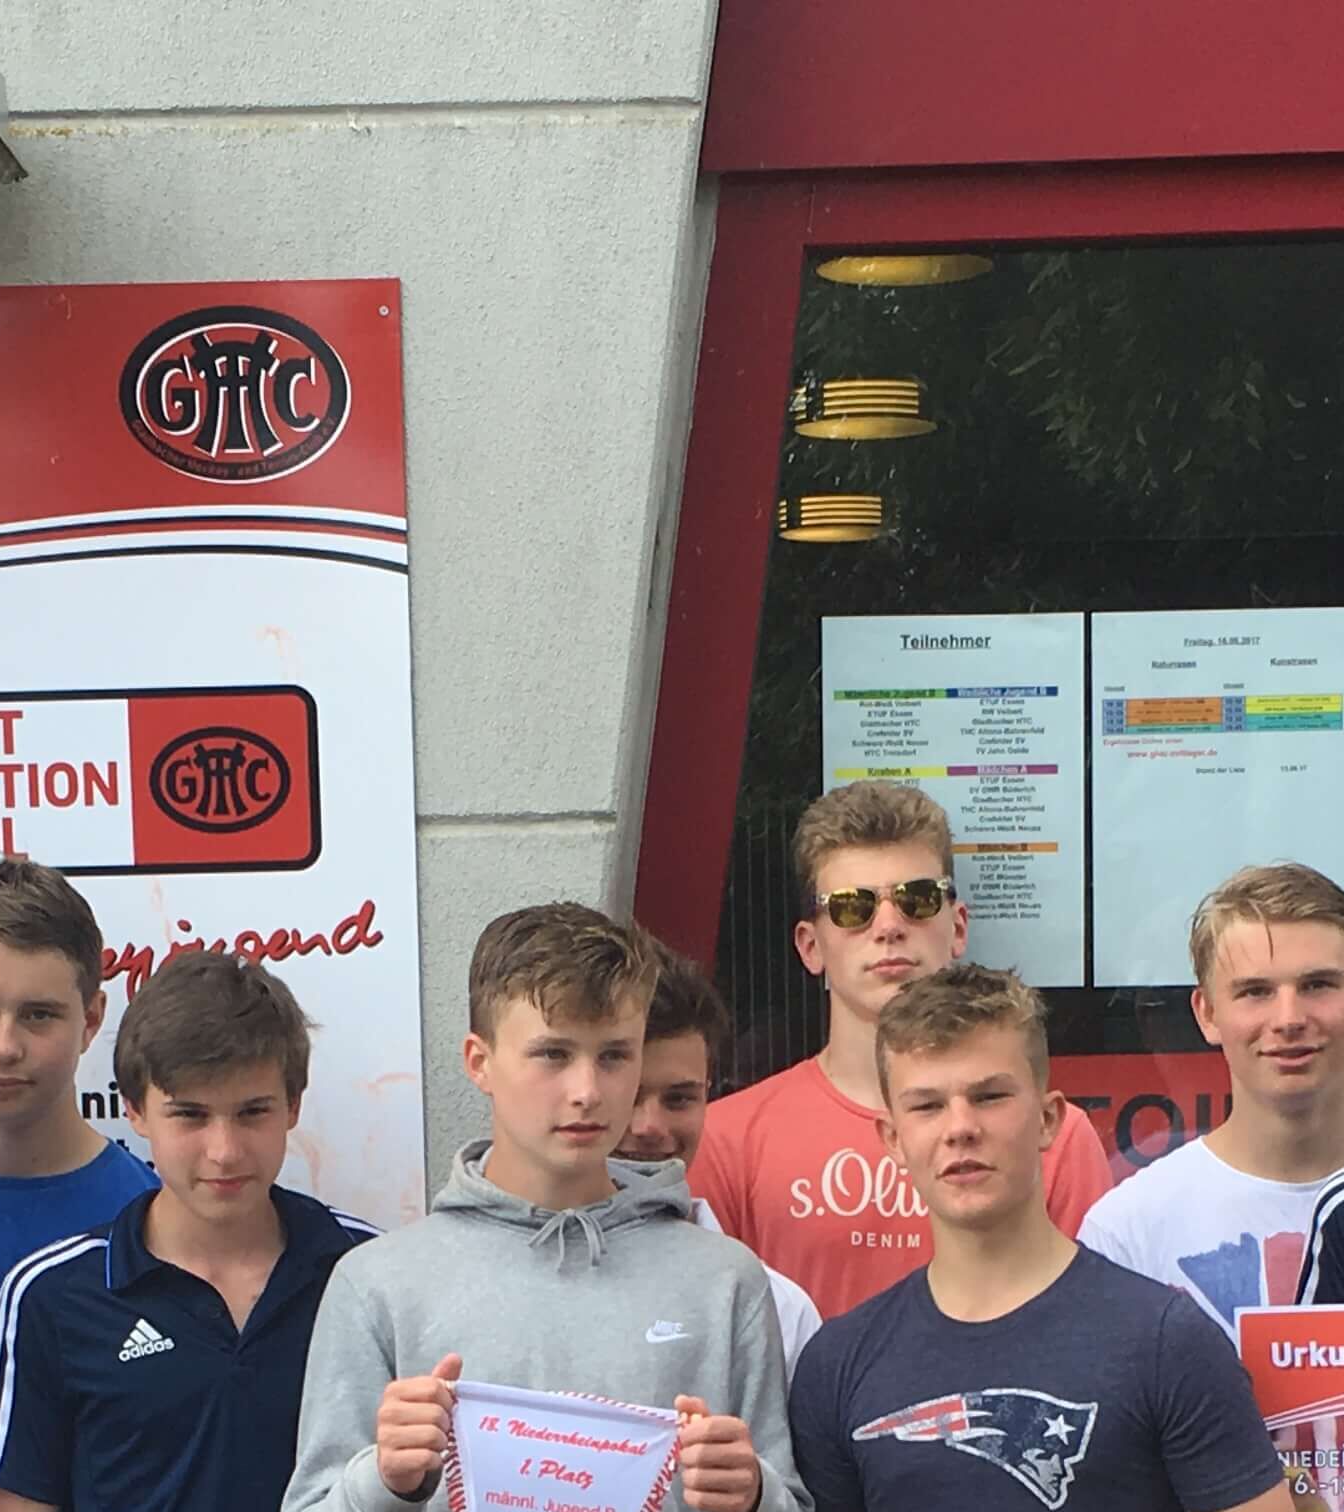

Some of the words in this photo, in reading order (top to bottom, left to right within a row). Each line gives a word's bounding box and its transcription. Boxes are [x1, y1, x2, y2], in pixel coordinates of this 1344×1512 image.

[900, 634, 991, 649] Teilnehmer
[851, 1231, 920, 1248] DENIM
[118, 1336, 176, 1363] adidas
[508, 1420, 648, 1456] Niederrheinpokal
[538, 1459, 593, 1490] Platz
[486, 1491, 538, 1509] männl.
